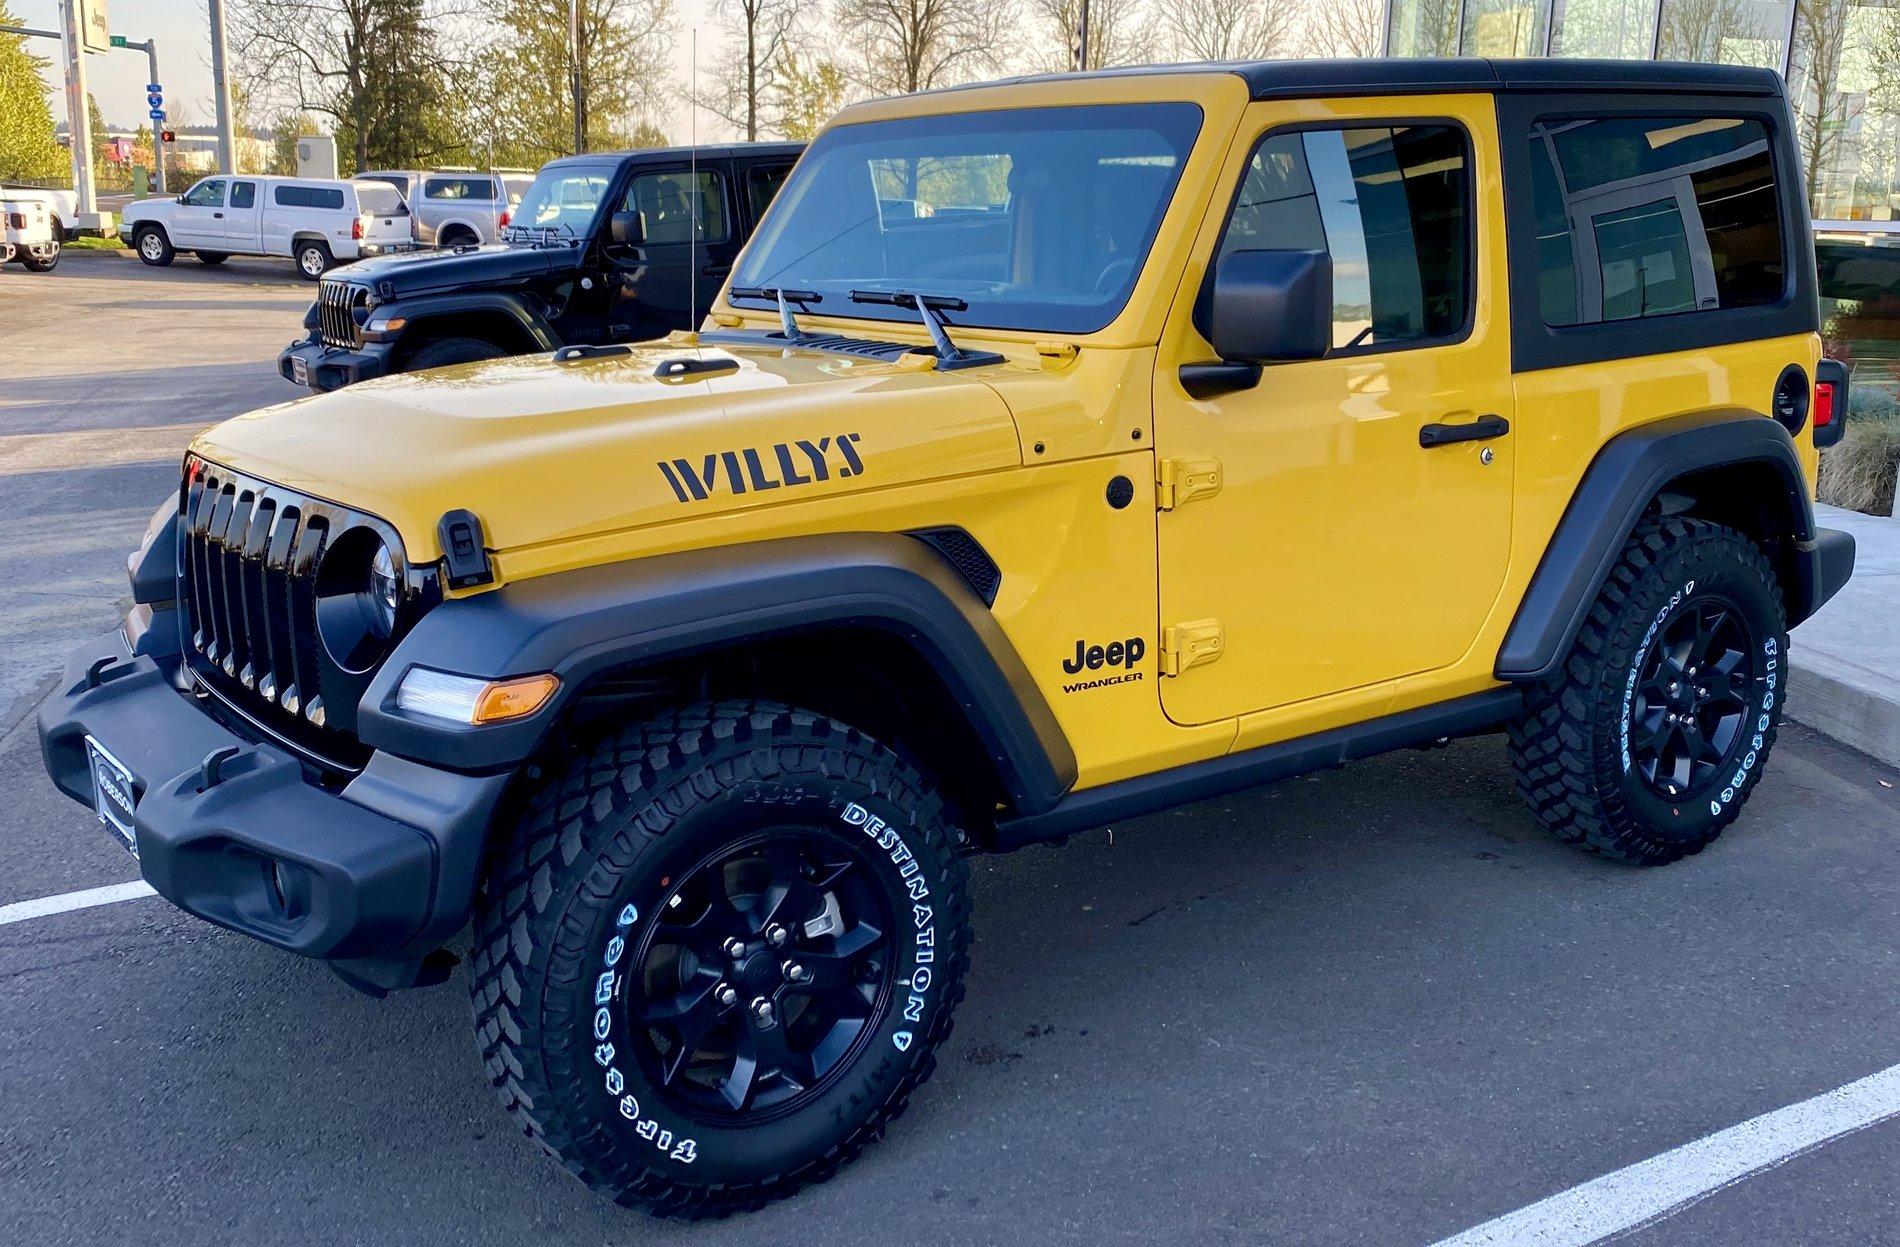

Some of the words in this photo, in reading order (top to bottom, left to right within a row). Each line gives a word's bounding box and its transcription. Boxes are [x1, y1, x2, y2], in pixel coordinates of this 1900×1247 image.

[657, 433, 864, 503] WILLYS
[1063, 637, 1144, 674] Jeep
[1063, 672, 1143, 693] WRANGLER
[841, 802, 934, 1022] DESTINATION
